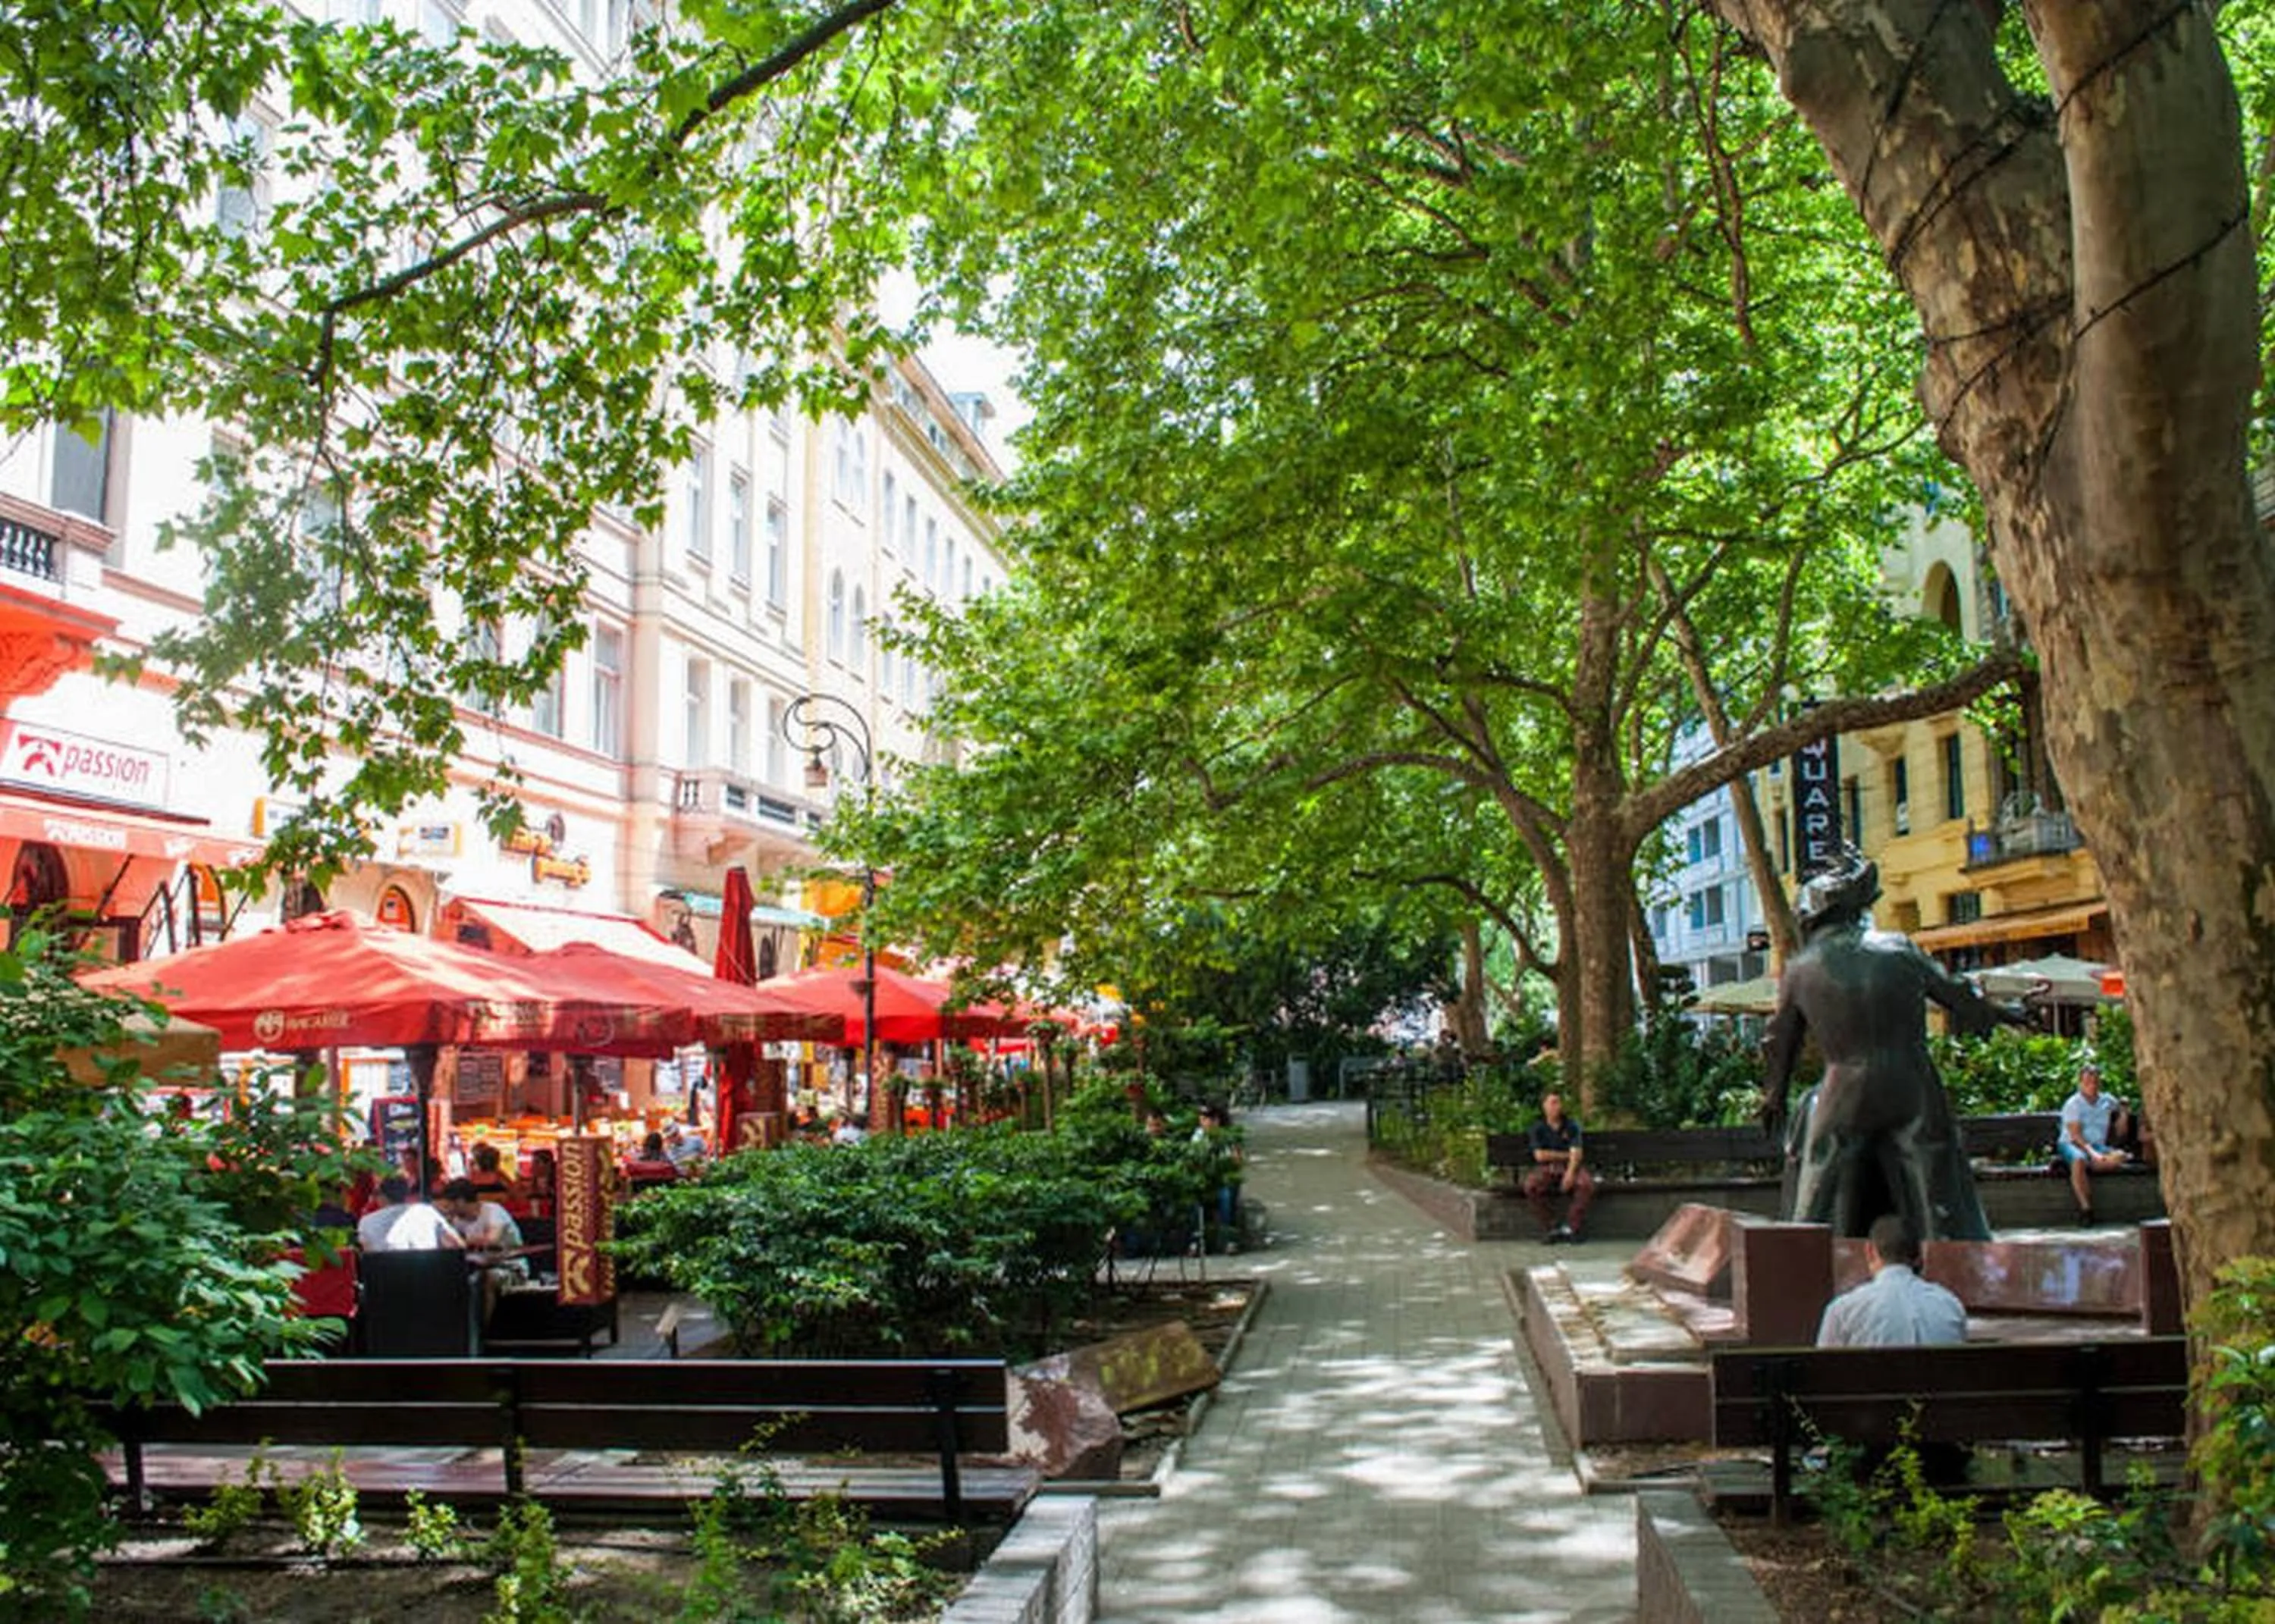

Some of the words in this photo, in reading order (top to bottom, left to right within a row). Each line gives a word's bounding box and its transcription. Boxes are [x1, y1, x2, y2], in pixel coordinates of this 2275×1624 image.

[60, 745, 150, 785] passion
[1801, 736, 1831, 861] QUARE
[562, 1140, 592, 1249] passion
